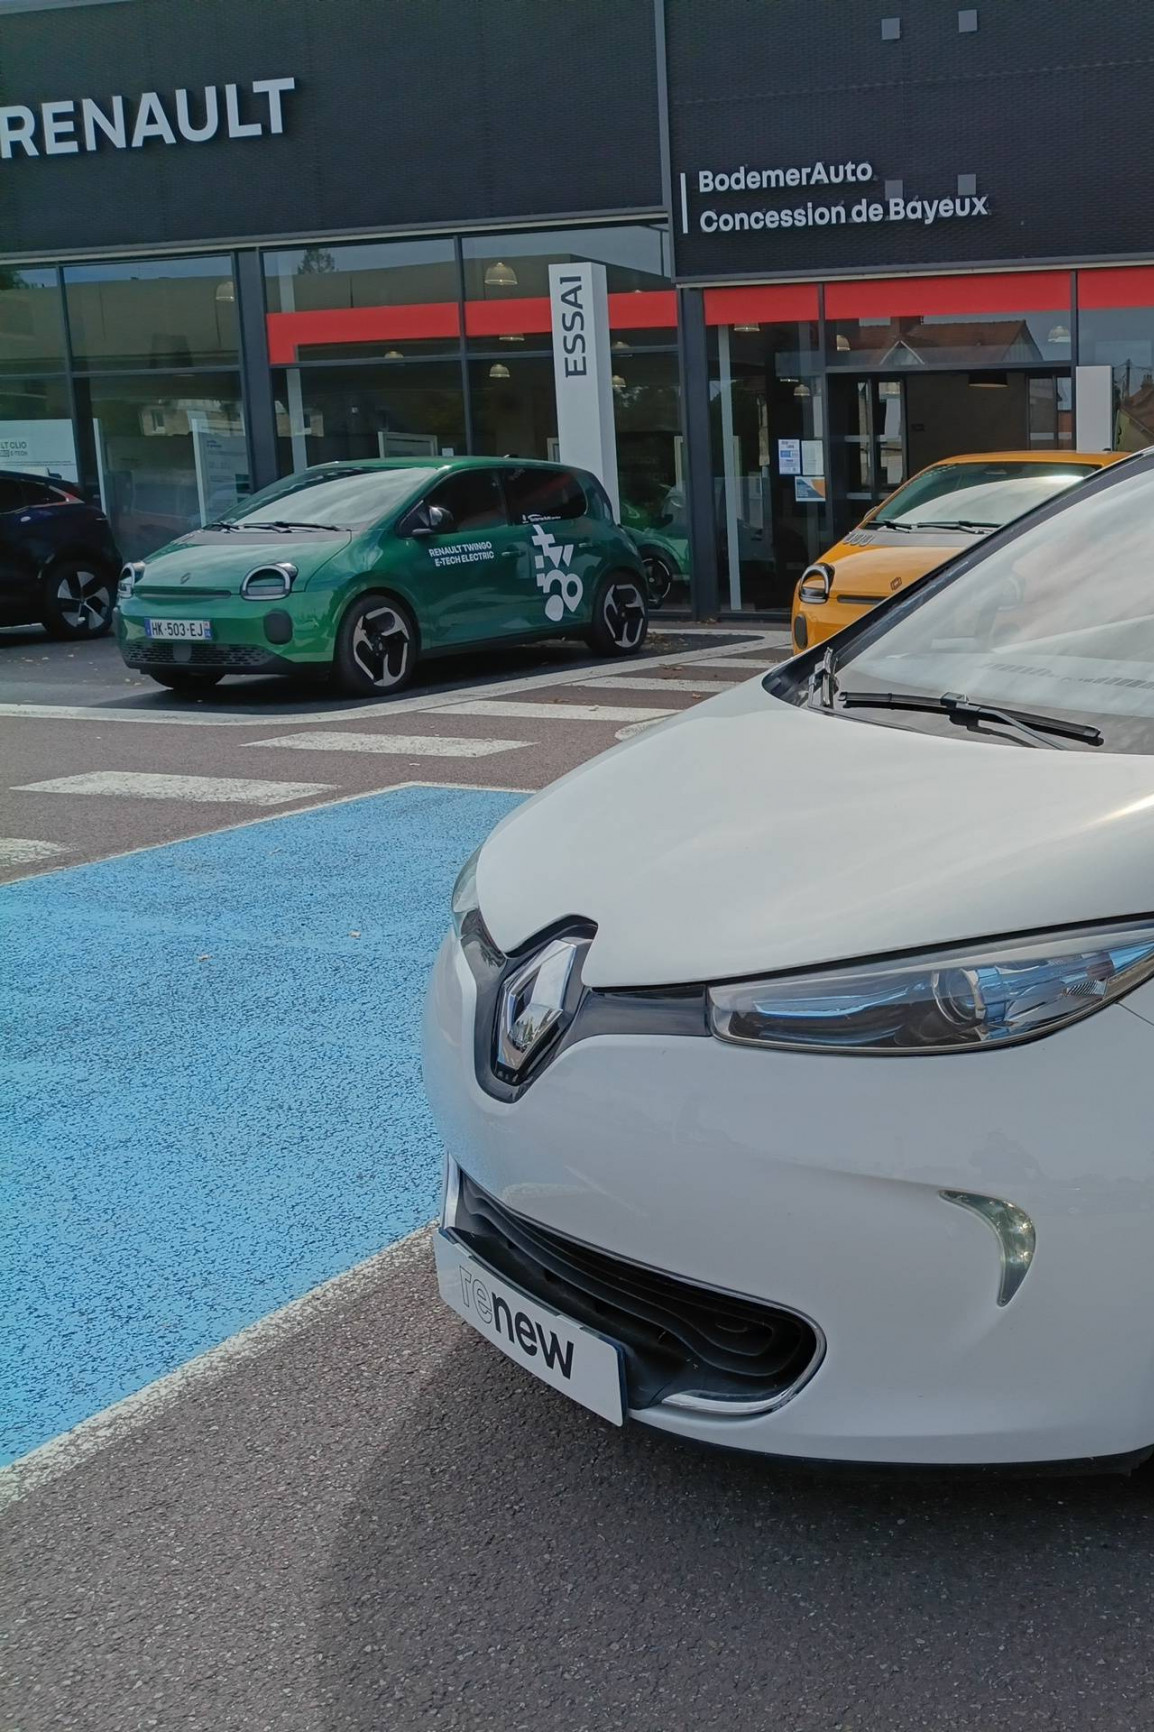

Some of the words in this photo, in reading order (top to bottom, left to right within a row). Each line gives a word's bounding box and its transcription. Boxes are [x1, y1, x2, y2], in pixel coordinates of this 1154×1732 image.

[0, 77, 295, 159] RENAULT
[699, 161, 873, 192] BodemerAuto
[699, 202, 846, 233] Concession
[851, 198, 884, 223] de
[889, 195, 989, 225] Bayeux
[559, 275, 587, 378] ESSAI
[428, 544, 462, 557] RENAULT
[462, 541, 492, 552] TWINGO
[434, 555, 461, 567] E-TECH
[461, 551, 495, 563] ELECTRIC
[458, 1264, 575, 1380] renew
